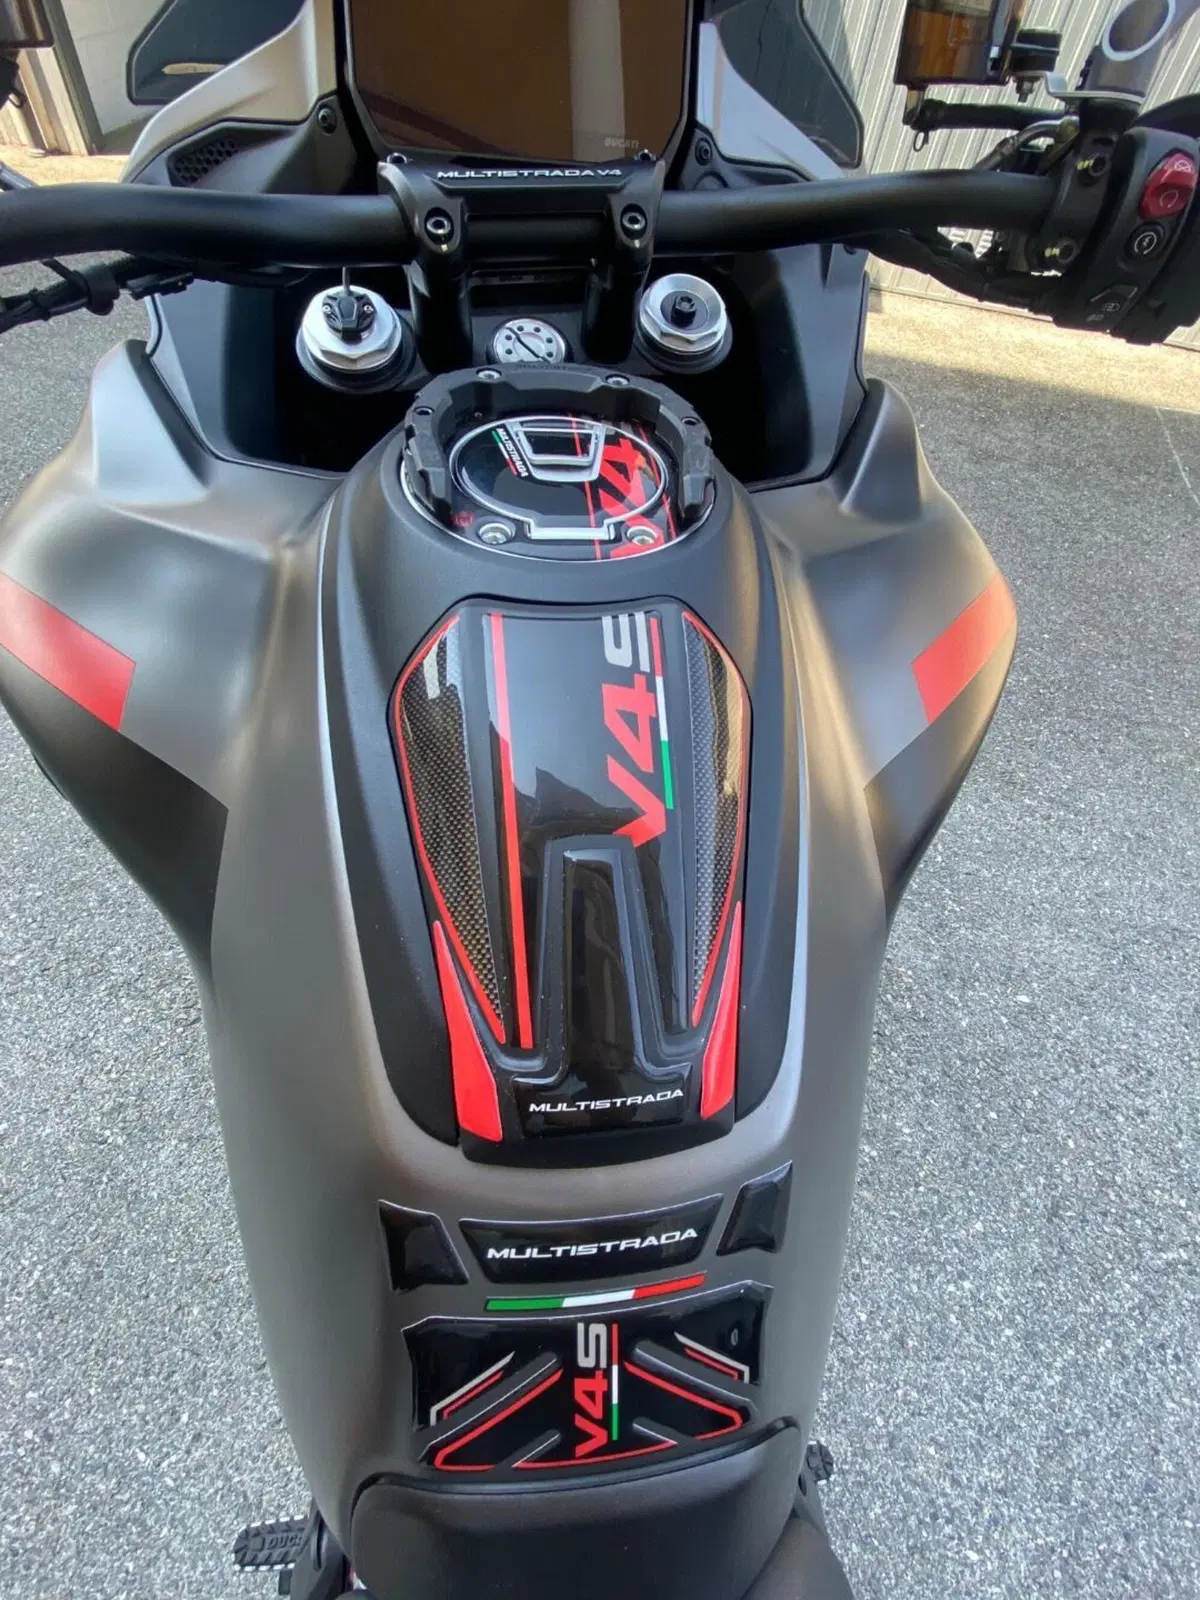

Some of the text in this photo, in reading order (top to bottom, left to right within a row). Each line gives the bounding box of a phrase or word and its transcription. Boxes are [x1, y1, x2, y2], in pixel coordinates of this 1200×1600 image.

[437, 168, 622, 178] MULTISTRADA V4
[496, 428, 529, 477] MULTISTRADA
[601, 611, 667, 848] V4S
[529, 1088, 684, 1112] MULTISTRADA
[487, 1228, 698, 1259] MULTISTRADA
[574, 1322, 608, 1458] V4S
